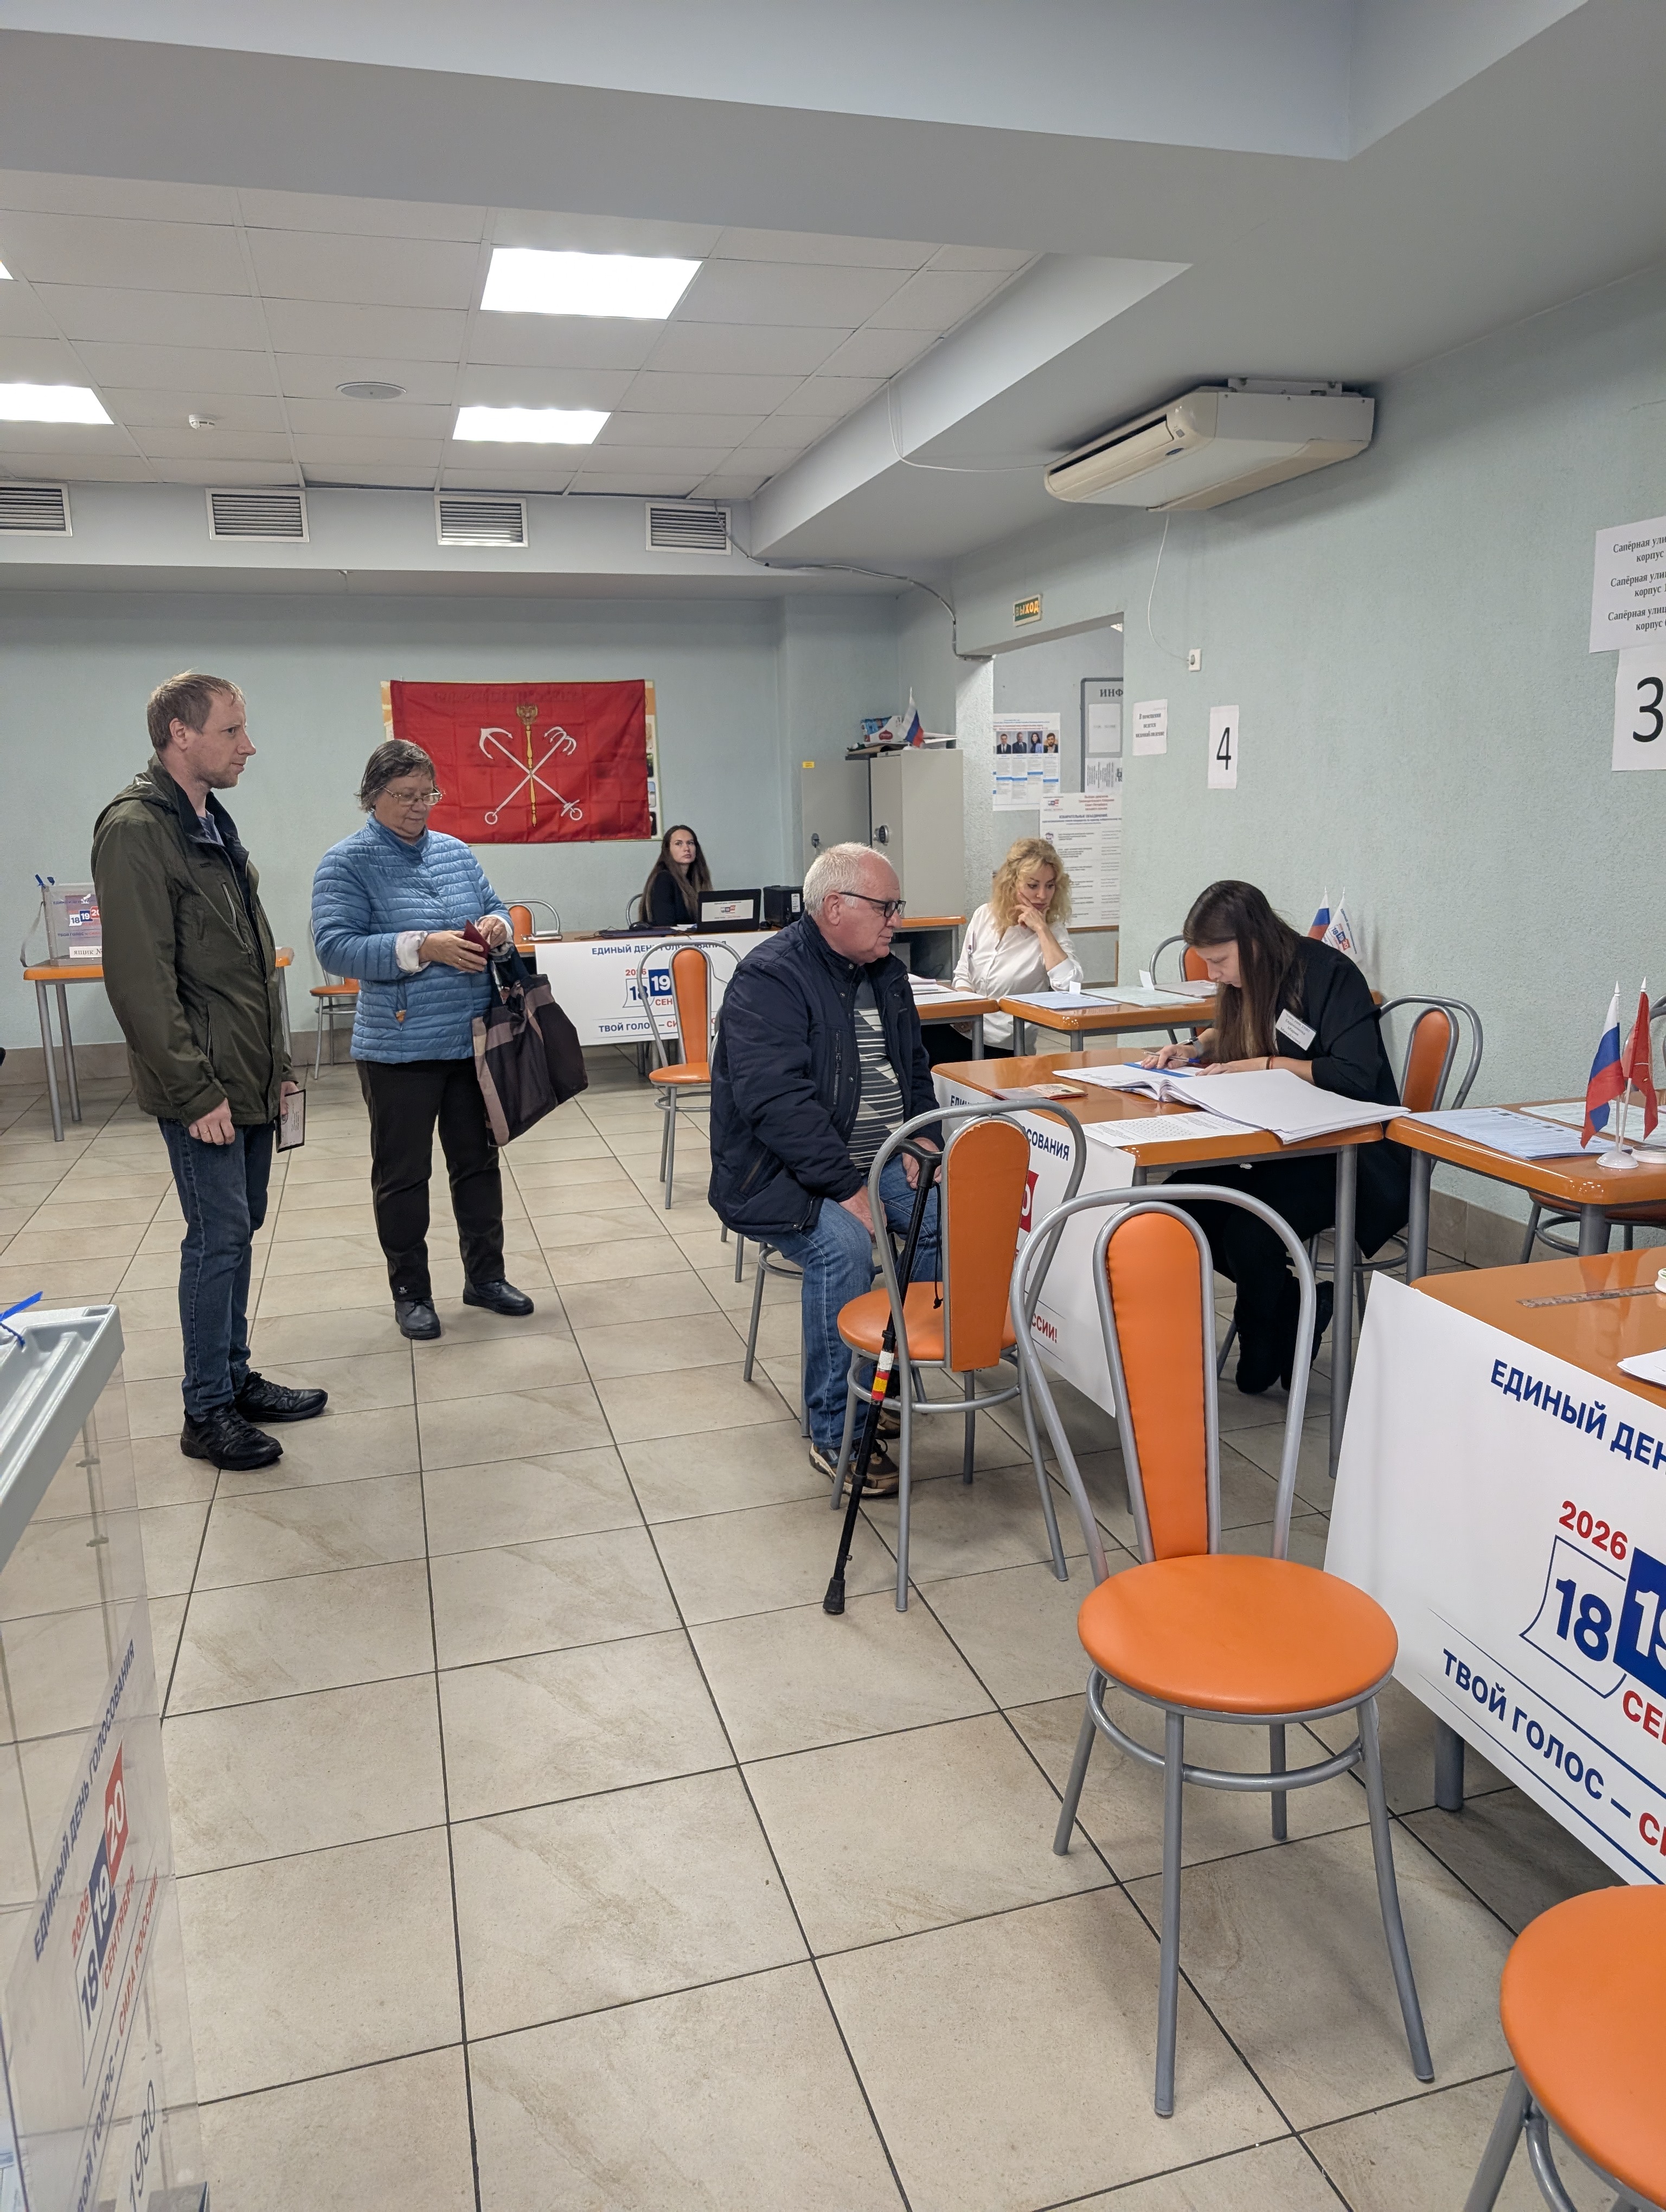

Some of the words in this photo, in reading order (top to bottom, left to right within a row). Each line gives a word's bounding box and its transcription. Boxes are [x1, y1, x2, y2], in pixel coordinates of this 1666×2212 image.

[1613, 538, 1650, 553] Сапёрная
[1636, 550, 1664, 563] корпус
[1610, 575, 1648, 587] Сапёрная
[1635, 586, 1662, 597] корпус
[1015, 600, 1040, 617] ВЫХОД
[1608, 610, 1646, 621] Сапёрная
[1636, 620, 1663, 632] корпус
[1632, 677, 1664, 743] 3
[1216, 727, 1232, 770] 4
[592, 944, 632, 955] ЕДИНЫЙ
[634, 944, 654, 953] ДЕН
[1331, 927, 1339, 936] 18
[1338, 933, 1344, 941] 19
[651, 975, 671, 991] 19
[599, 1023, 624, 1032] ТВОЙ
[626, 1022, 650, 1031] ГОЛО
[1022, 1126, 1070, 1161] СОВАНИЯ
[1491, 1358, 1607, 1441] ЕДИНЫЙ
[1559, 1500, 1627, 1560] 2026
[1555, 1579, 1612, 1662] 18
[1443, 1647, 1508, 1732] ТВОЙ
[1511, 1706, 1604, 1800] ГОЛОС
[34, 1830, 71, 1963] ЕДИНЫЙ
[70, 1779, 89, 1853] ДЕНЬ
[89, 1638, 135, 1785] ГОЛОСОВАНИЯ
[72, 1887, 89, 1958] 2026
[81, 1948, 99, 2030] 18
[93, 1863, 110, 1941] 19
[106, 1779, 125, 1866] 20
[104, 1863, 134, 1990] СЕНТЯБРЯ
[93, 2055, 115, 2158] ГОЛОС
[119, 1964, 136, 2037] СИЛА
[130, 2079, 156, 2212] 1980
